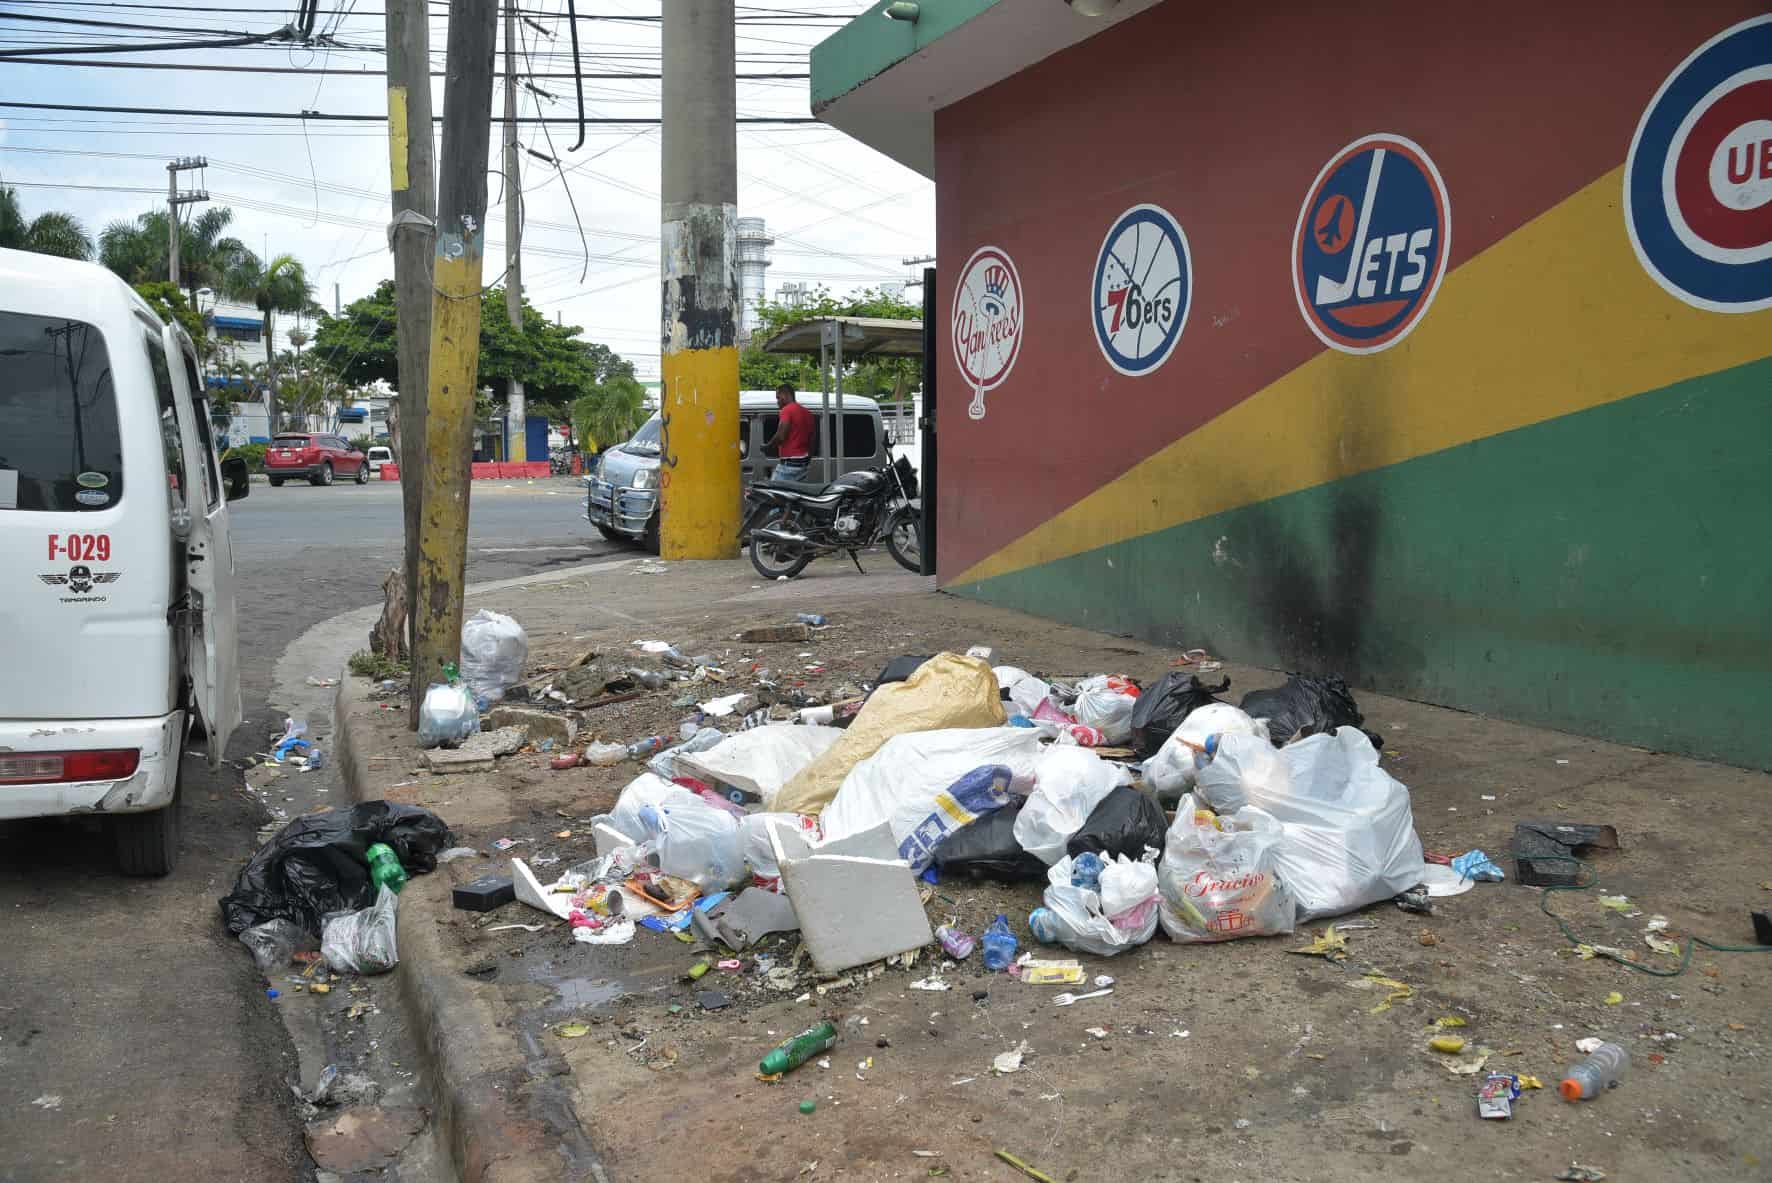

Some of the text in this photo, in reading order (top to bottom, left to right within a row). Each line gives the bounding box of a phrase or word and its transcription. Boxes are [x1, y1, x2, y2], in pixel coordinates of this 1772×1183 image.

[1315, 148, 1432, 305] JETS
[955, 306, 1020, 368] Yankees
[1107, 284, 1172, 334] 76ers
[48, 533, 111, 562] F-029
